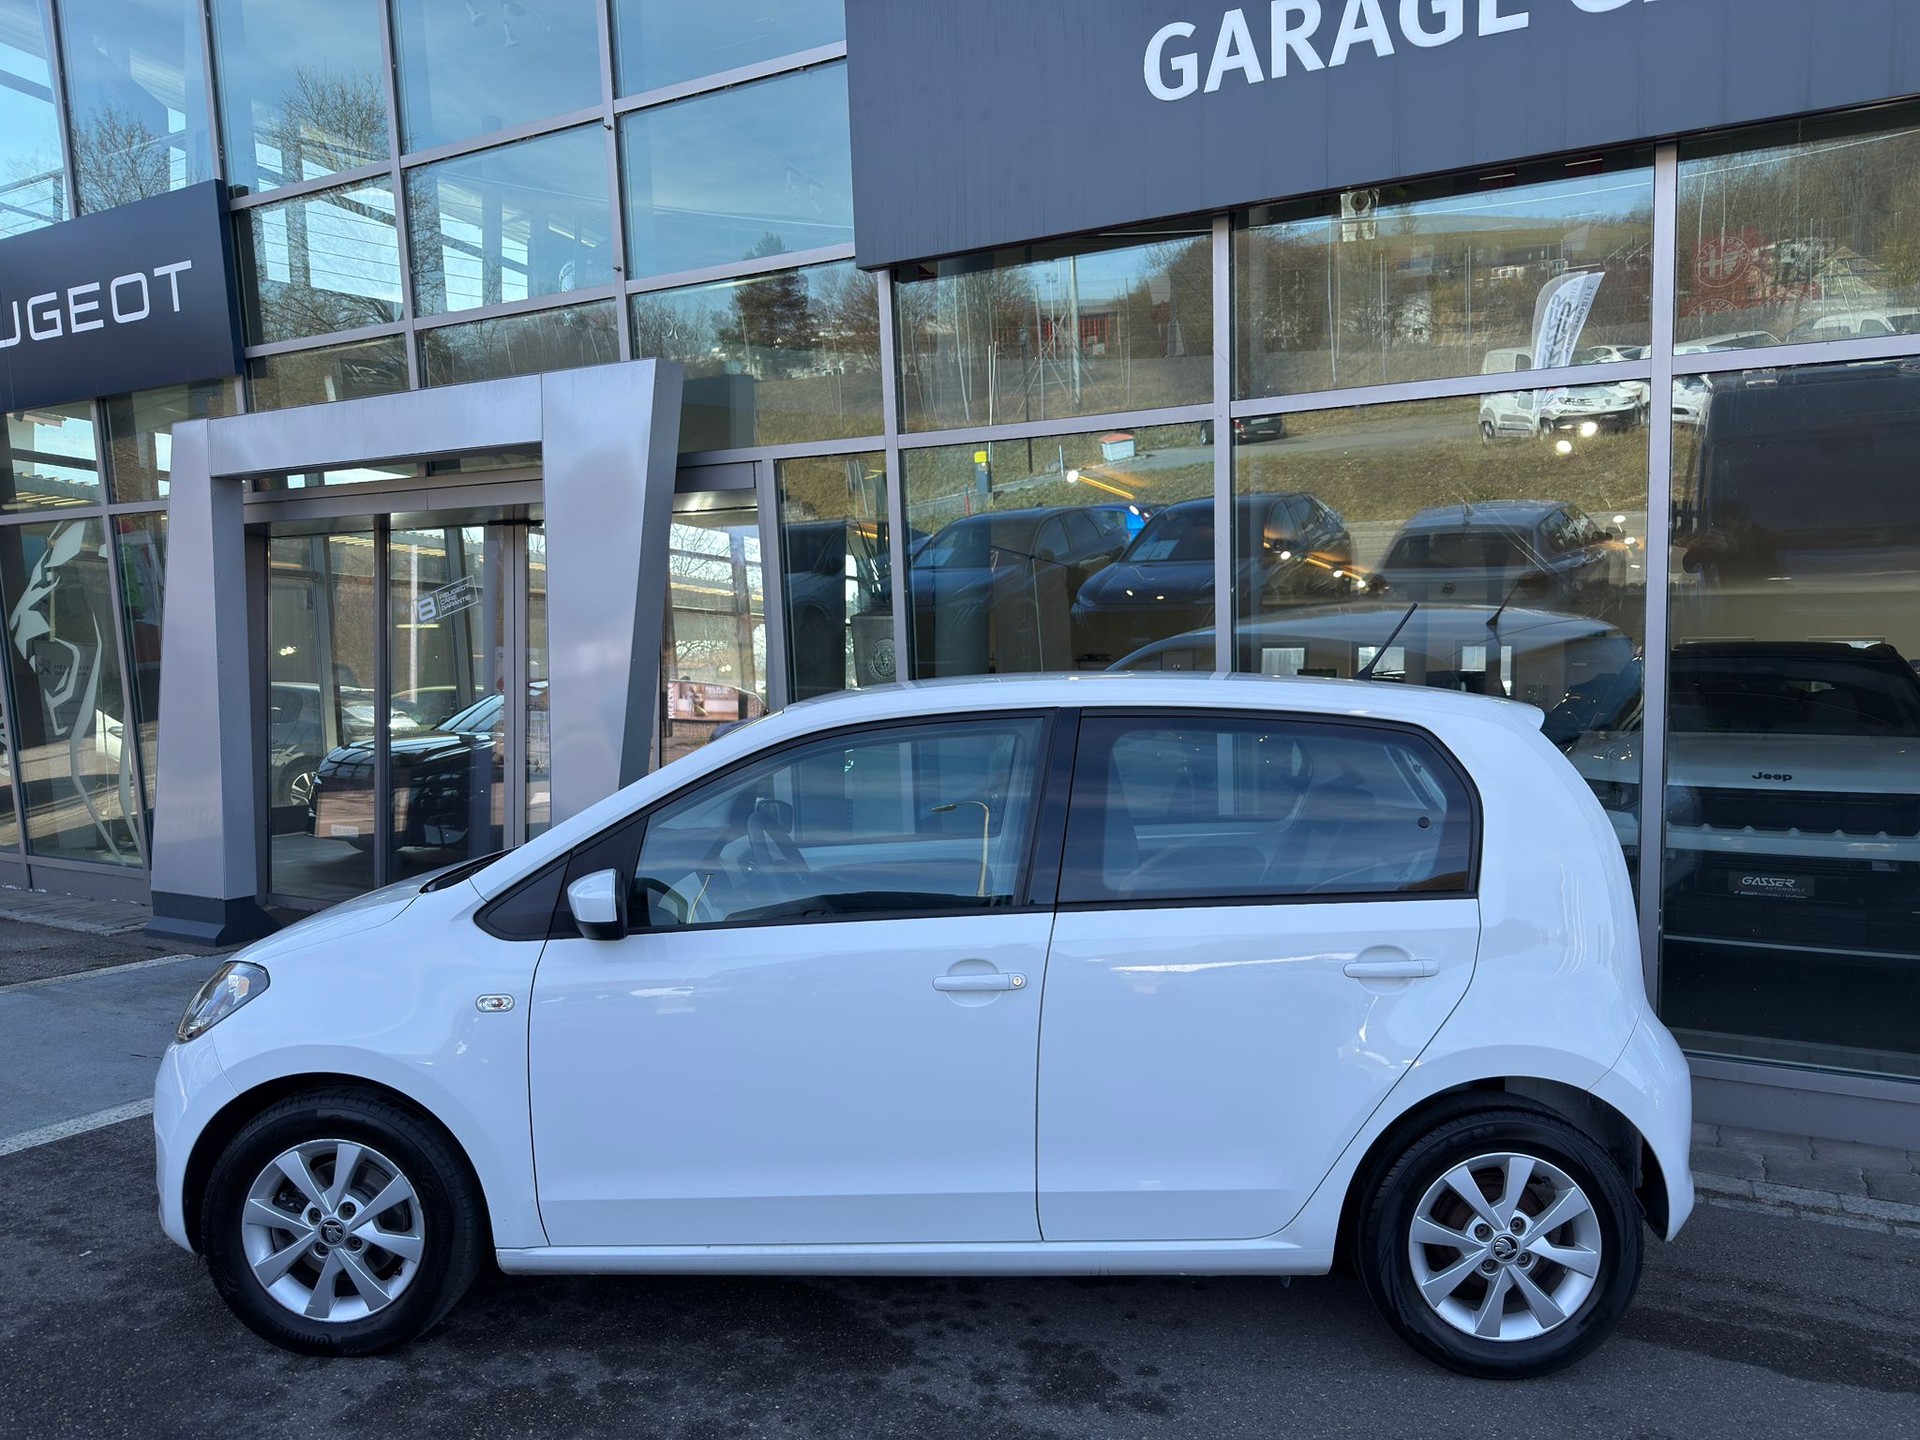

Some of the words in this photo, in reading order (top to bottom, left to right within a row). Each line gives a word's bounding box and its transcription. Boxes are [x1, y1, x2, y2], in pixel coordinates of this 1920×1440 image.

[1565, 283, 1595, 353] AUTOMOBILE
[439, 584, 470, 599] PEUGEOT
[1752, 771, 1792, 782] Jeep
[1741, 876, 1796, 887] GASSER
